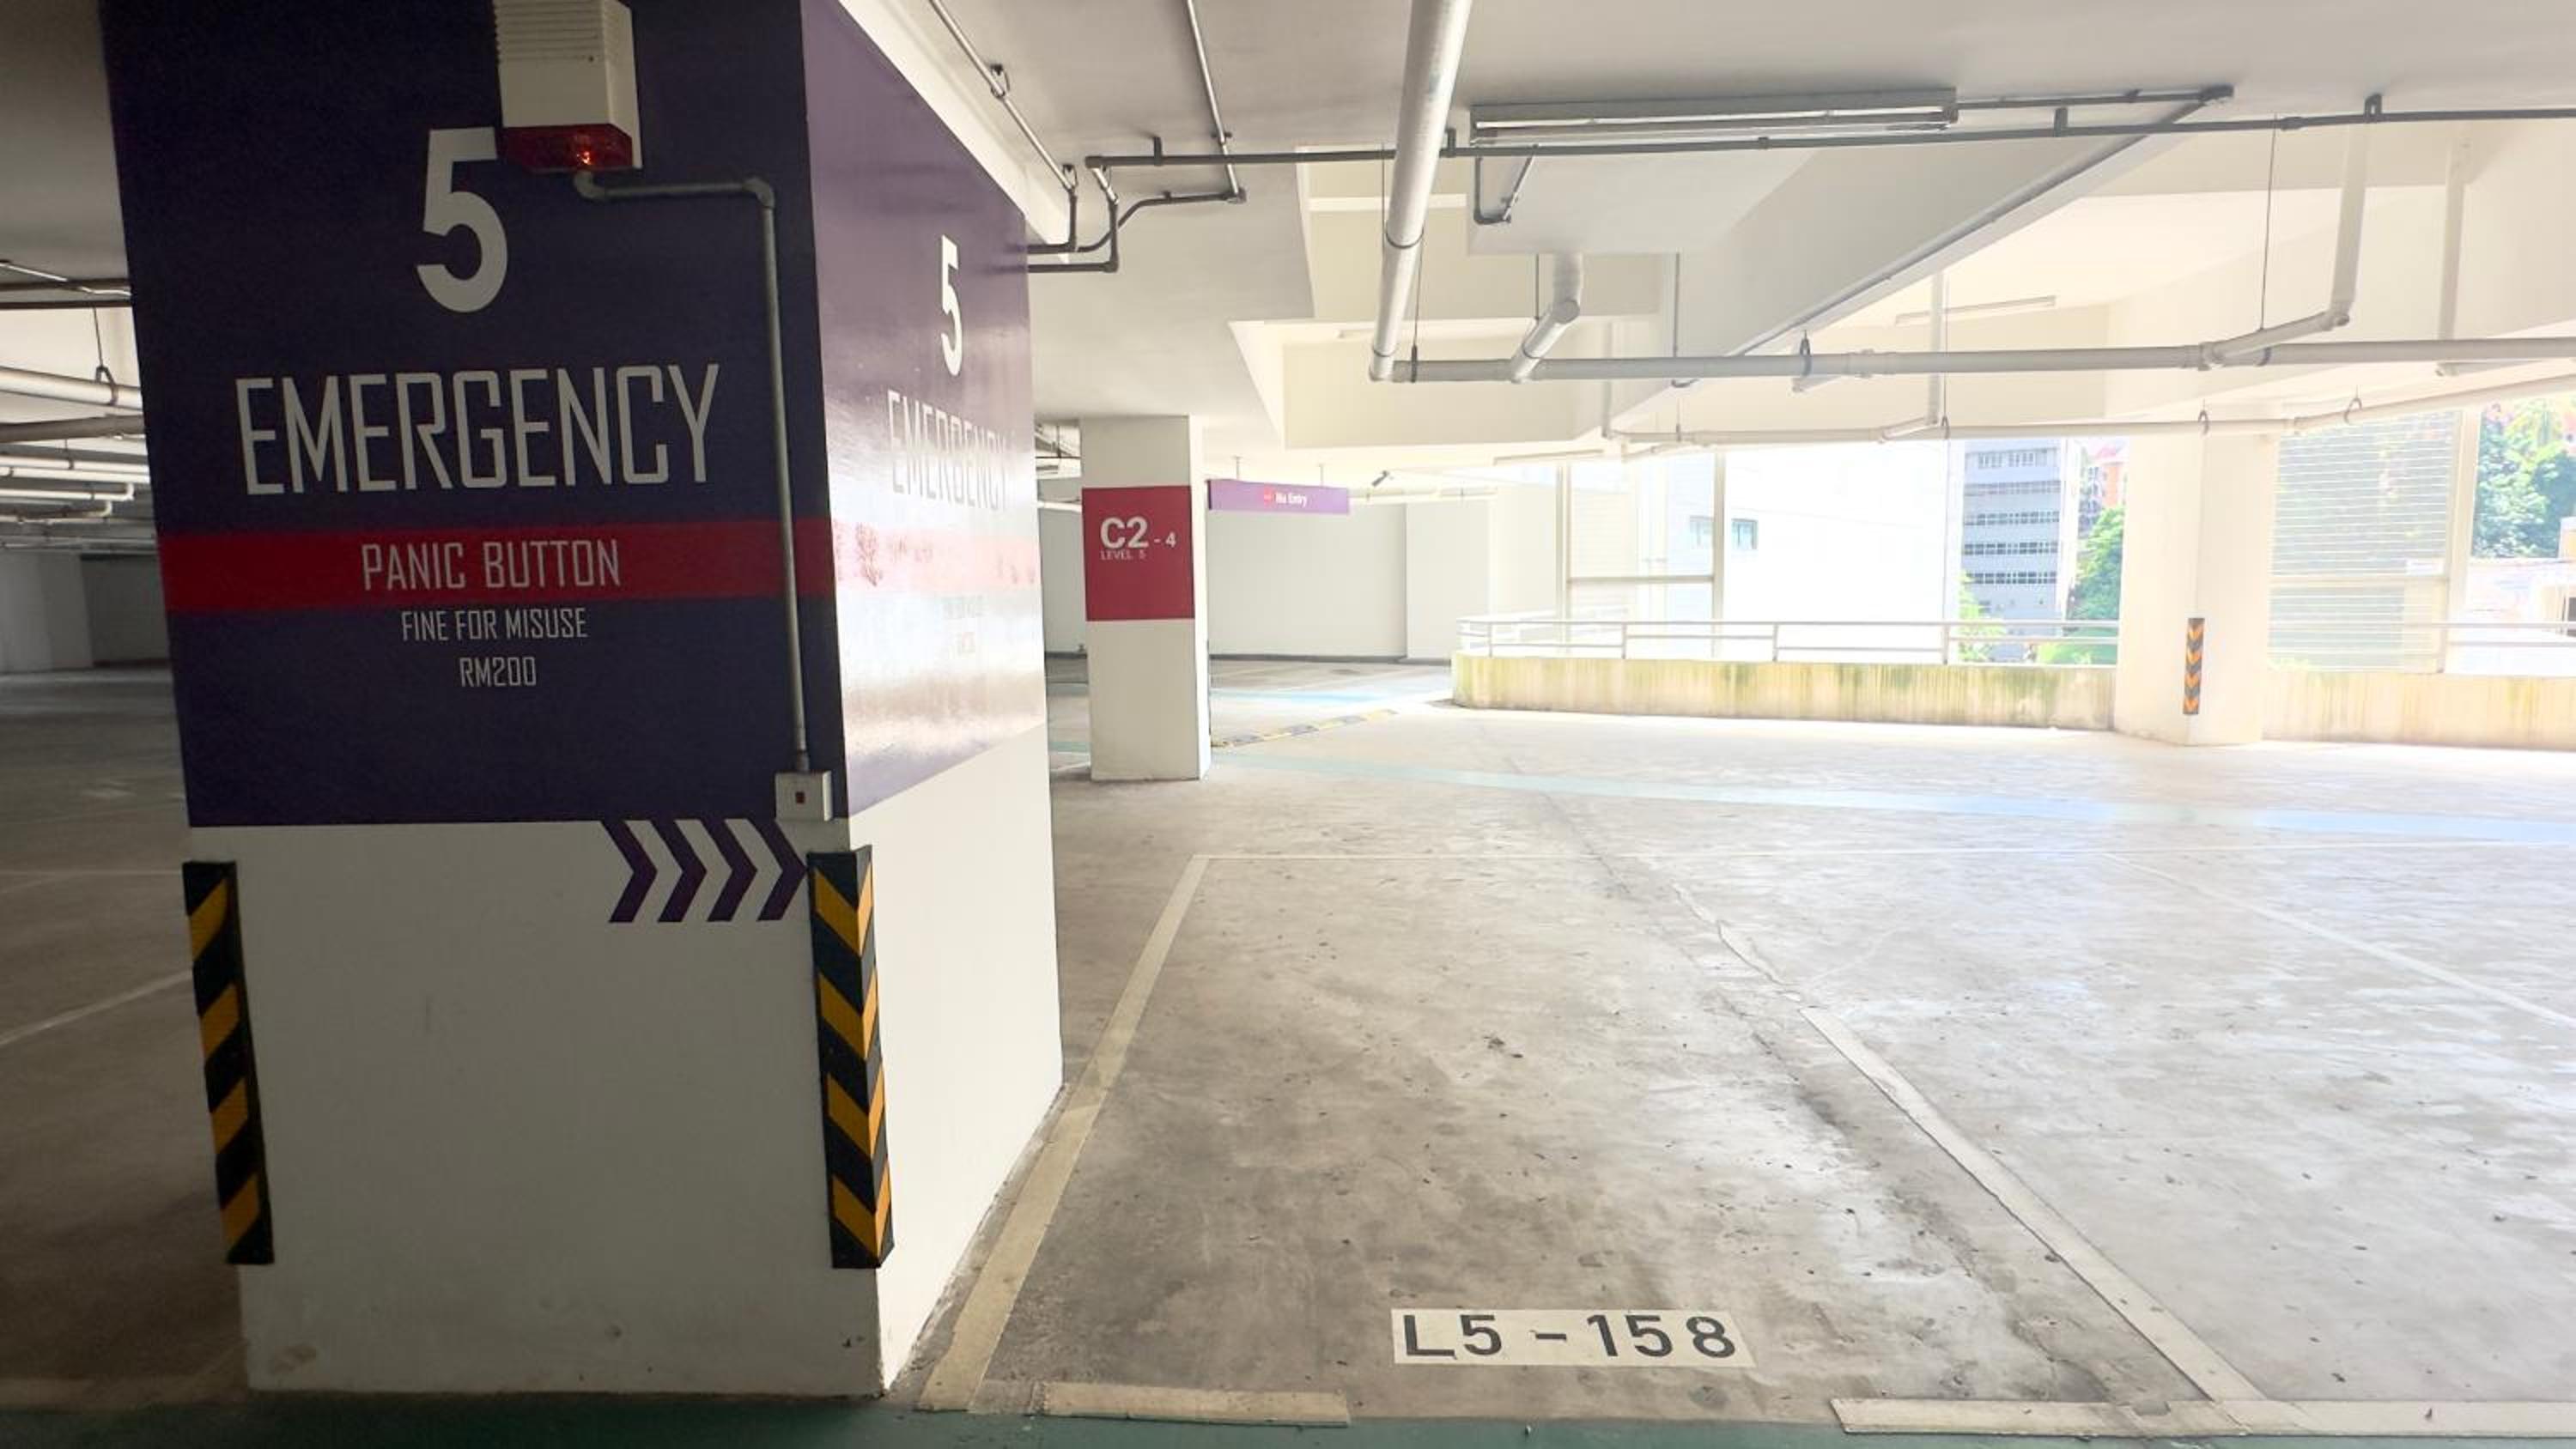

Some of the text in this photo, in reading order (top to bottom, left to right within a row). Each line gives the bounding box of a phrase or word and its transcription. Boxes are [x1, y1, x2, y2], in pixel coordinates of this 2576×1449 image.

[416, 127, 508, 313] 5
[940, 233, 963, 378] 5
[235, 363, 720, 495] EMERGENCY
[1100, 517, 1149, 549] C2
[361, 539, 621, 591] PANIC BUTTON
[1100, 549, 1133, 561] LEVEL
[401, 608, 589, 641] FINE FOR MISUSE
[459, 656, 538, 688] RM200
